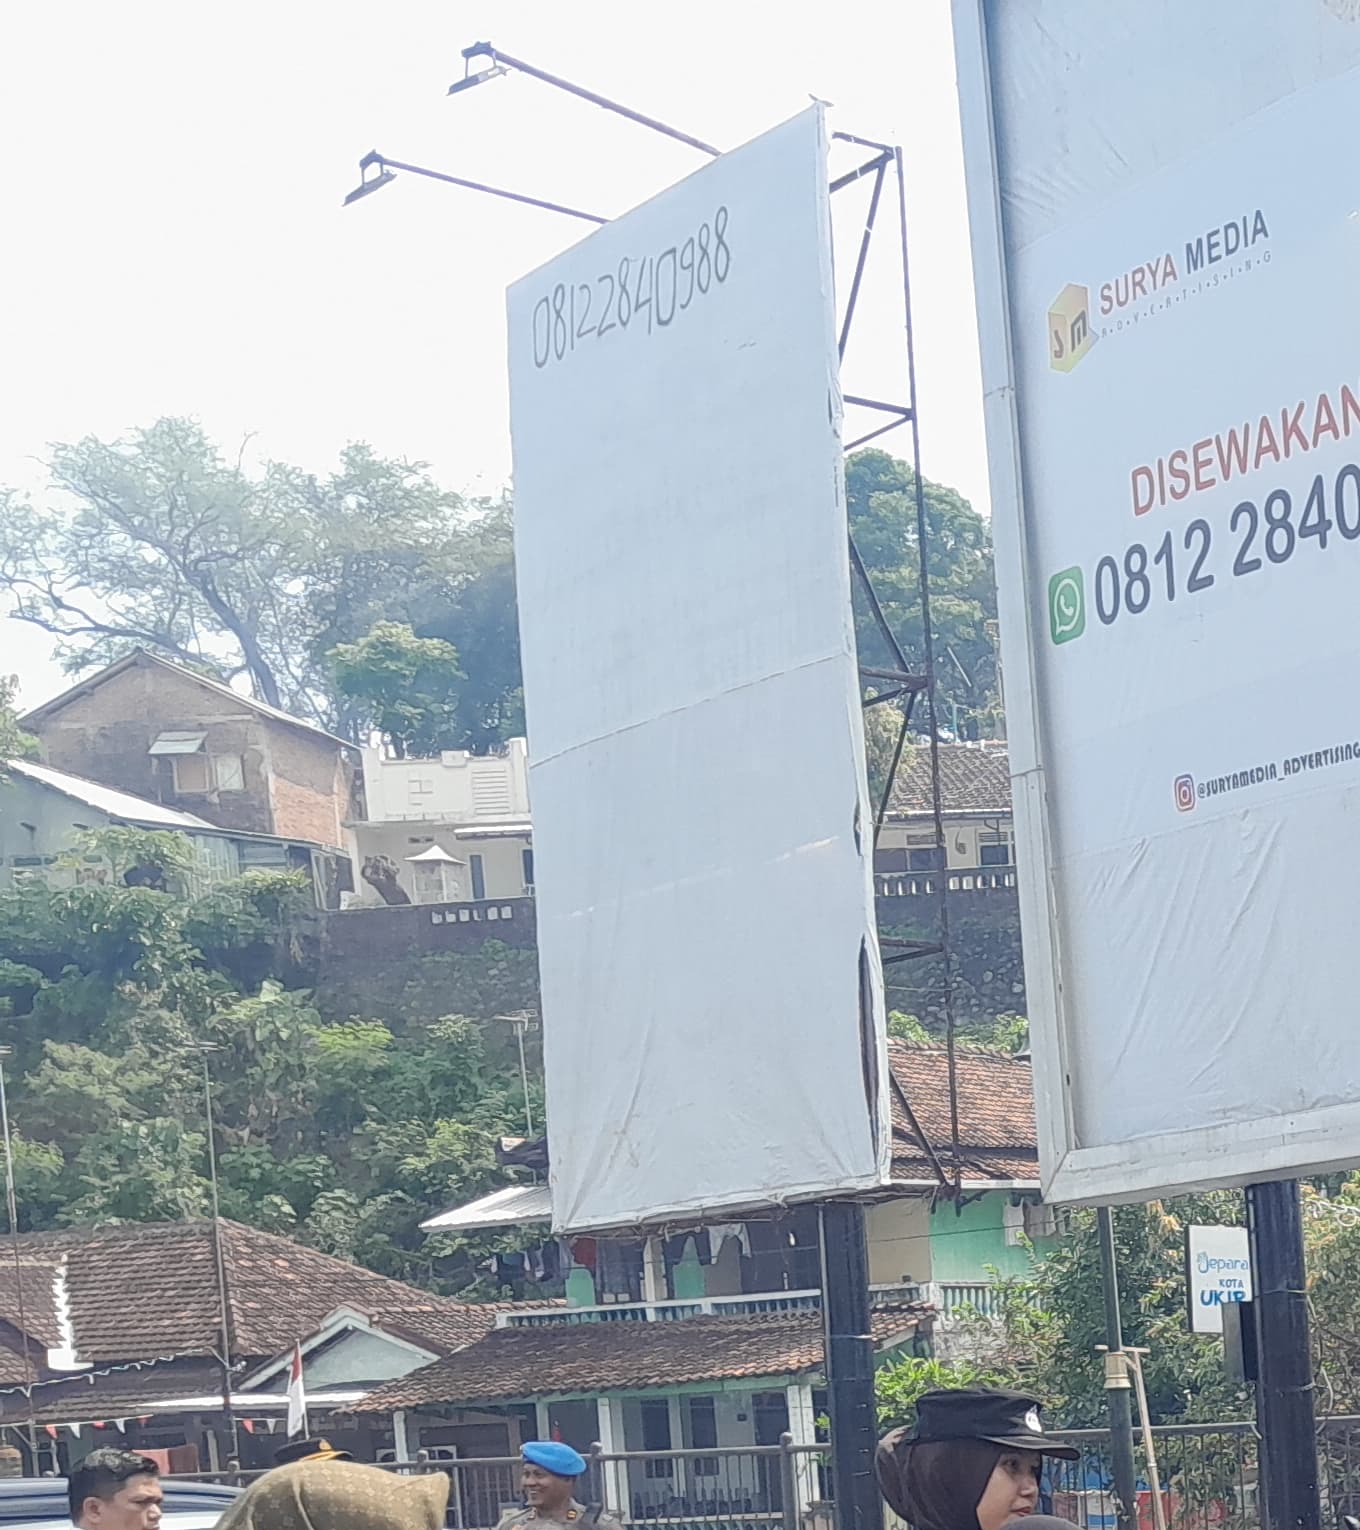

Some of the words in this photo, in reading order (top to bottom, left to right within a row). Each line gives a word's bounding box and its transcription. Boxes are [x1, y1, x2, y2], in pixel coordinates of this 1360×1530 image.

[1100, 253, 1178, 315] SURYA
[1185, 209, 1269, 275] MEDIA
[1094, 518, 1214, 625] 0812
[1197, 1251, 1249, 1273] Jepara
[1218, 1279, 1244, 1289] KOTA
